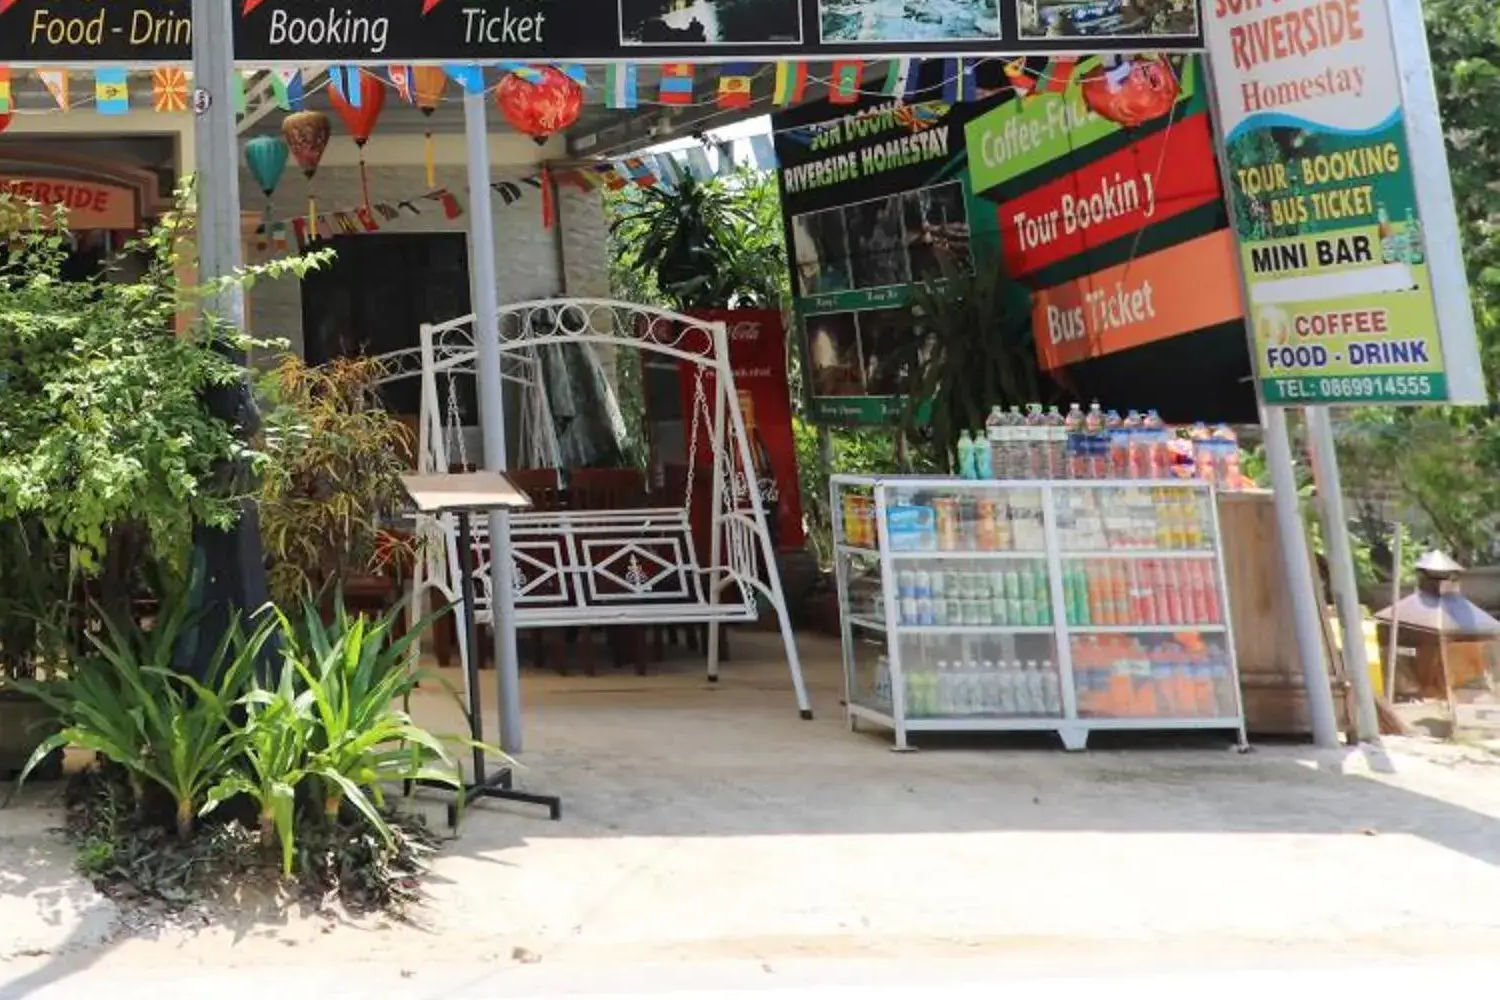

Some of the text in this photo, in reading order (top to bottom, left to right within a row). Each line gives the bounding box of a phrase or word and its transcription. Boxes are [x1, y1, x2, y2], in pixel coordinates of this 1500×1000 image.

[30, 7, 106, 45] Food
[129, 9, 192, 45] Drin
[269, 7, 389, 53] Booking
[461, 7, 545, 43] Ticket
[1240, 65, 1366, 113] Homestay
[783, 126, 949, 194] RIVERSIDE HOMESTAY
[1237, 163, 1288, 196] TOUR
[1302, 142, 1400, 186] BOOKING
[1269, 185, 1373, 226] BUS TICKET
[1013, 209, 1061, 252] Tour
[1251, 235, 1373, 274] MINI BAR
[1047, 279, 1156, 345] Bus Ticket
[1294, 309, 1389, 338] COFFEE
[1267, 345, 1328, 369] FOOD
[1347, 340, 1430, 366] DRINK
[1275, 378, 1316, 398] TEL:
